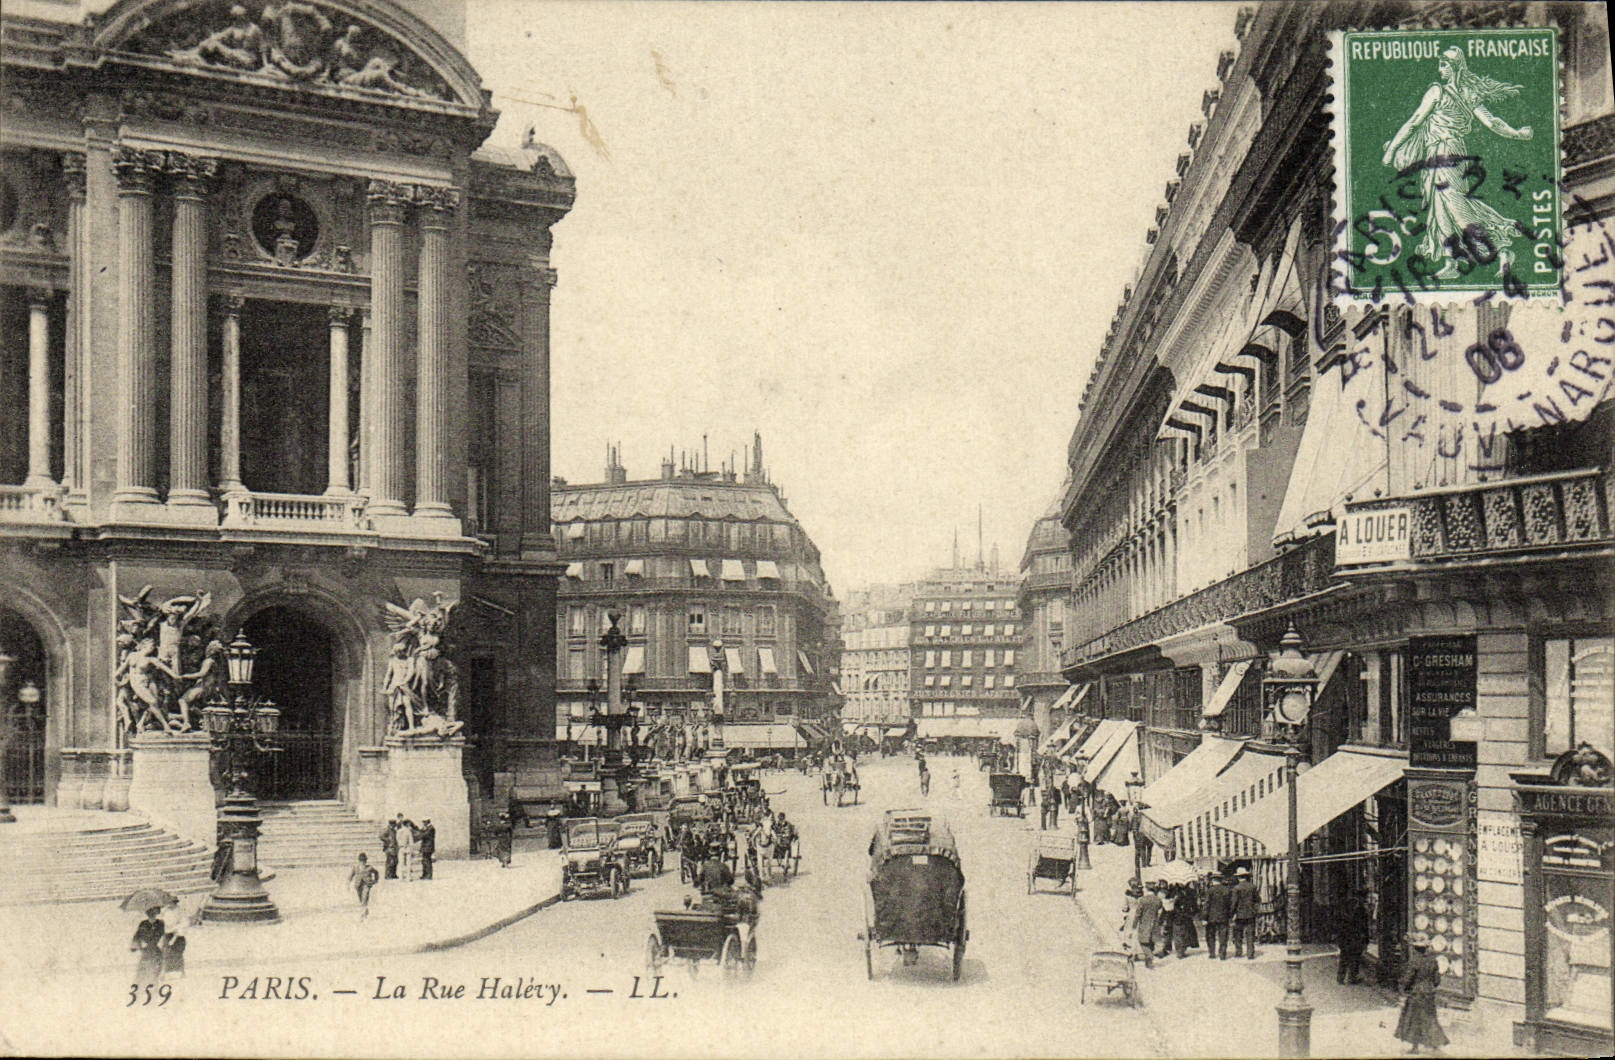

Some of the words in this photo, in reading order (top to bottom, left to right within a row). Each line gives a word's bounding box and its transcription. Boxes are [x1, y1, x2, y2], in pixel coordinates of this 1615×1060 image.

[1352, 39, 1441, 61] REPUBLIQUE
[1467, 37, 1549, 60] FRANÇAISE
[1532, 188, 1553, 274] POSTES
[1465, 327, 1526, 385] 08
[1338, 519, 1349, 546] A
[1355, 513, 1408, 544] LOUER
[1425, 653, 1474, 668] GRESHAM
[1415, 692, 1472, 703] ASSURANCES
[1534, 794, 1584, 813] AGENCE
